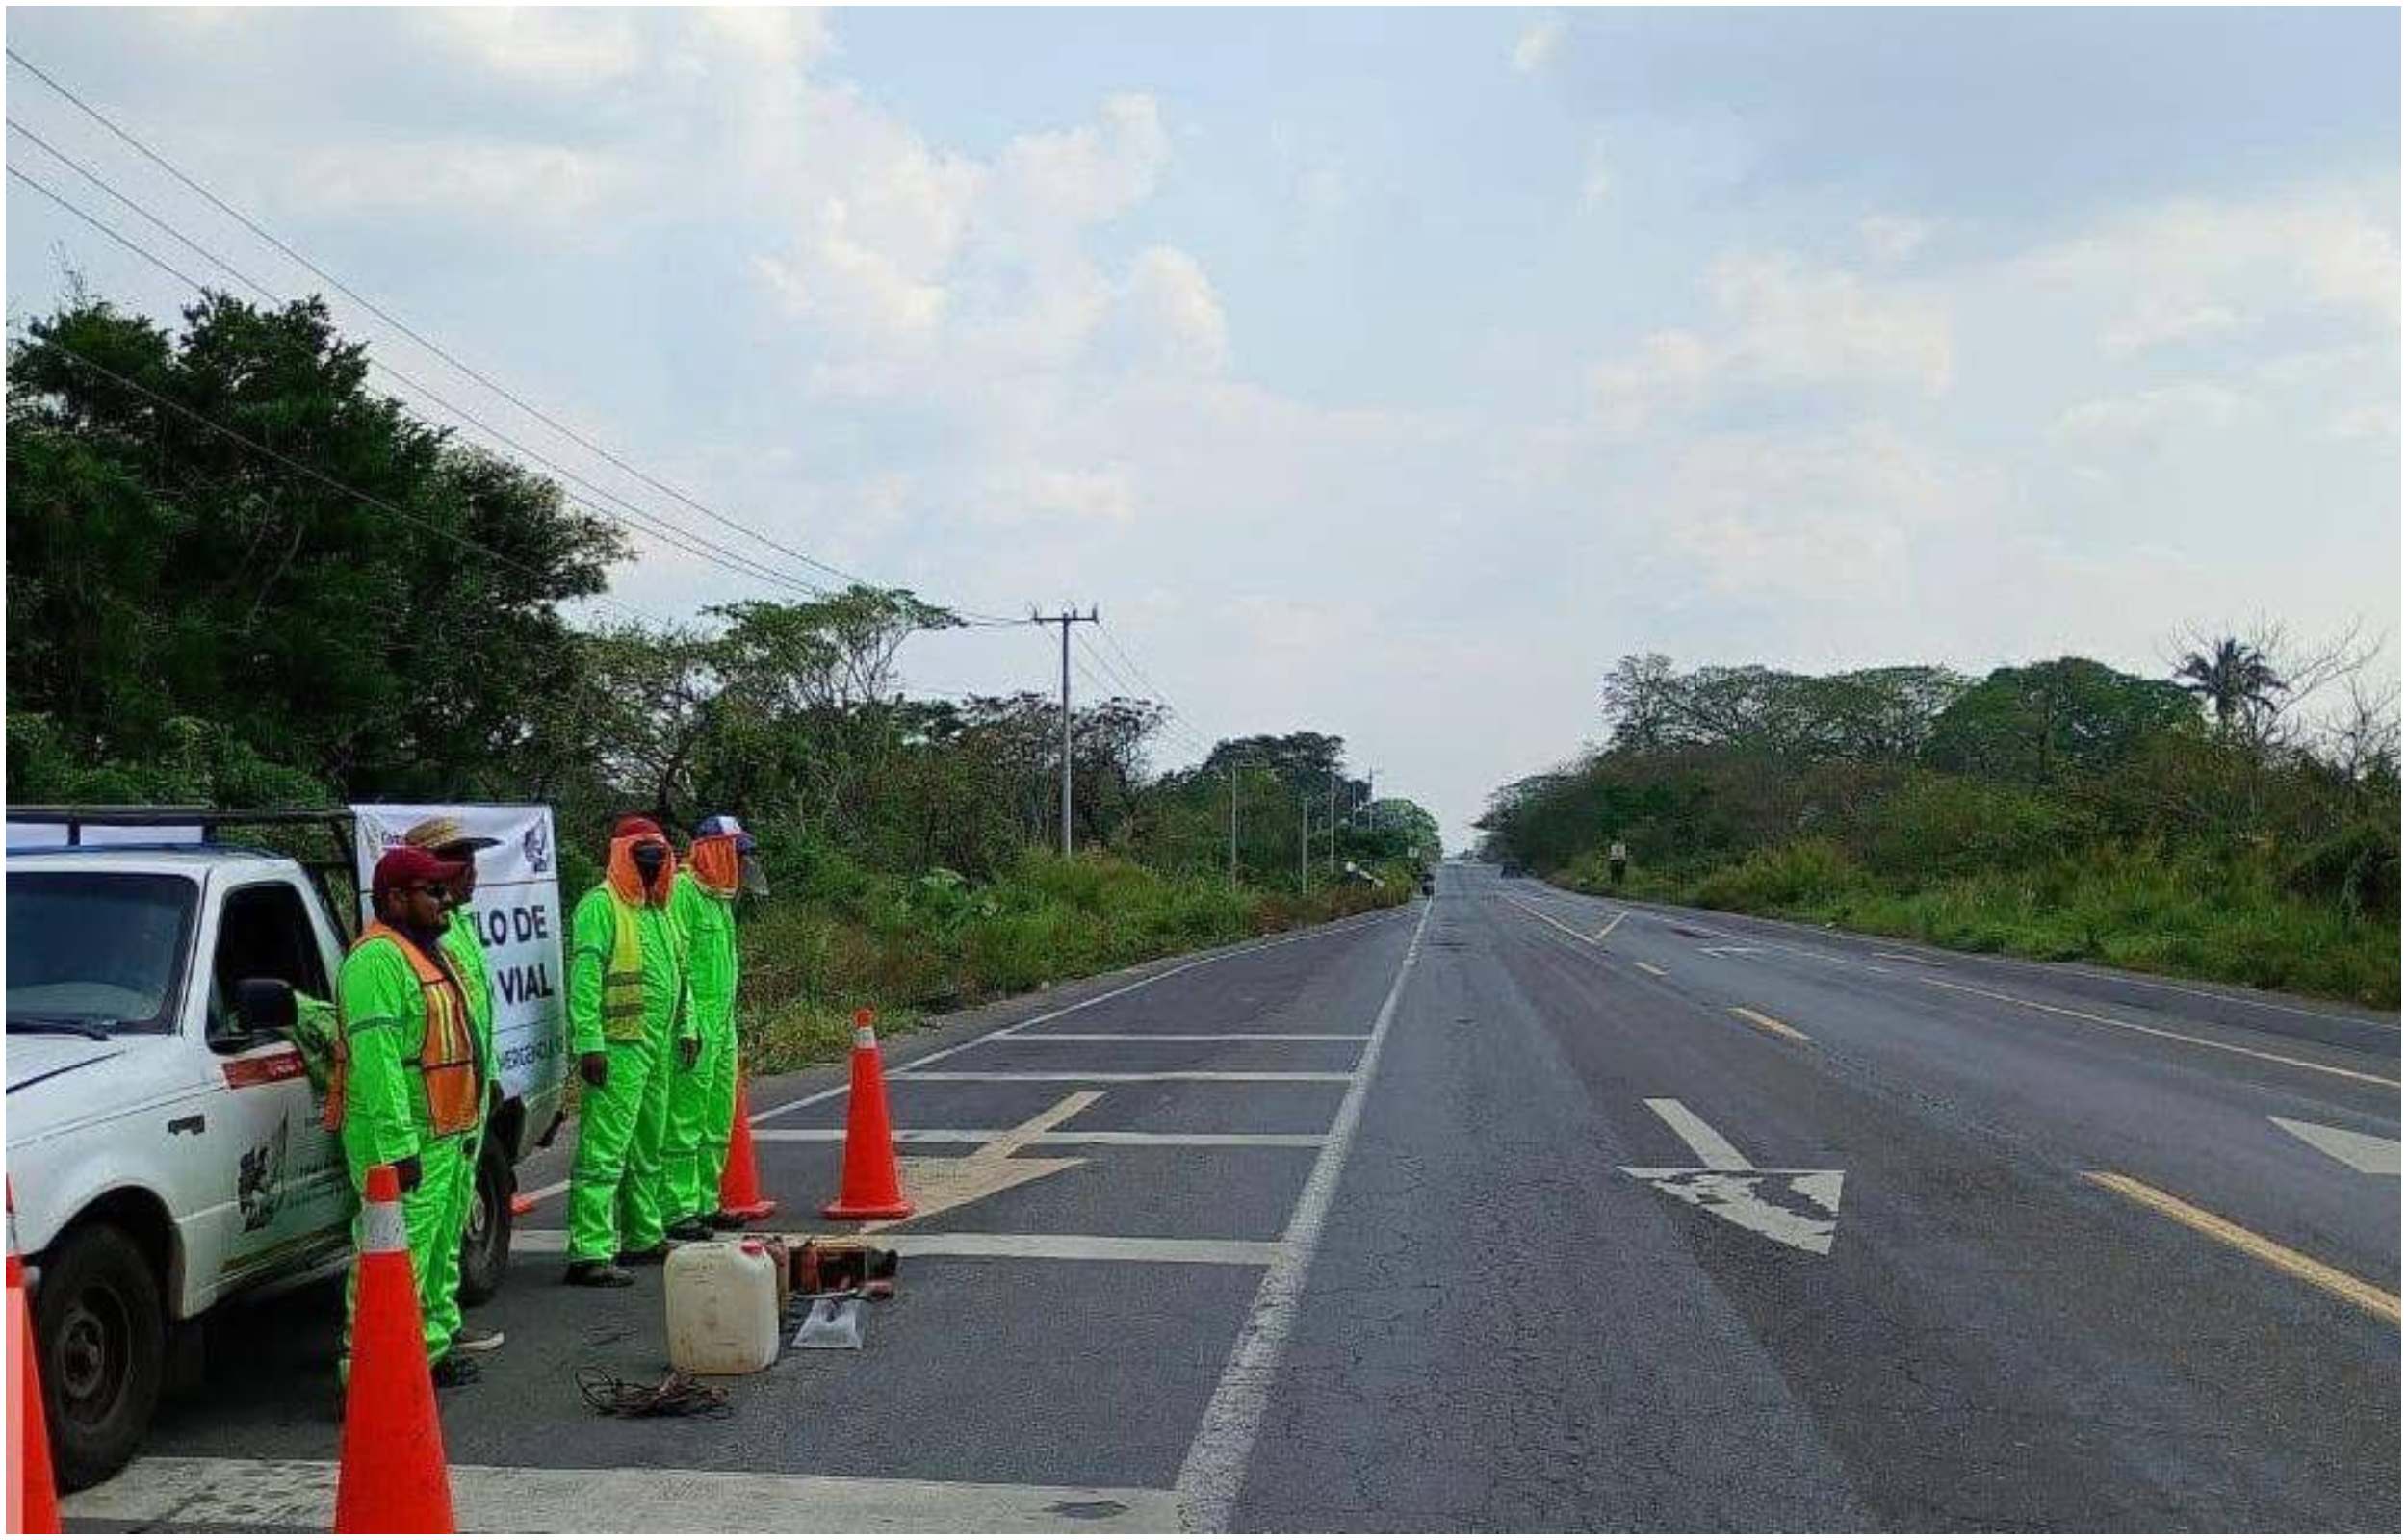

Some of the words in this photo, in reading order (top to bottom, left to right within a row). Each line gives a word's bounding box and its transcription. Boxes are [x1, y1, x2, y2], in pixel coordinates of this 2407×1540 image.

[471, 909, 507, 948] LO
[513, 905, 548, 943] DE
[497, 962, 555, 1005] VIAL
